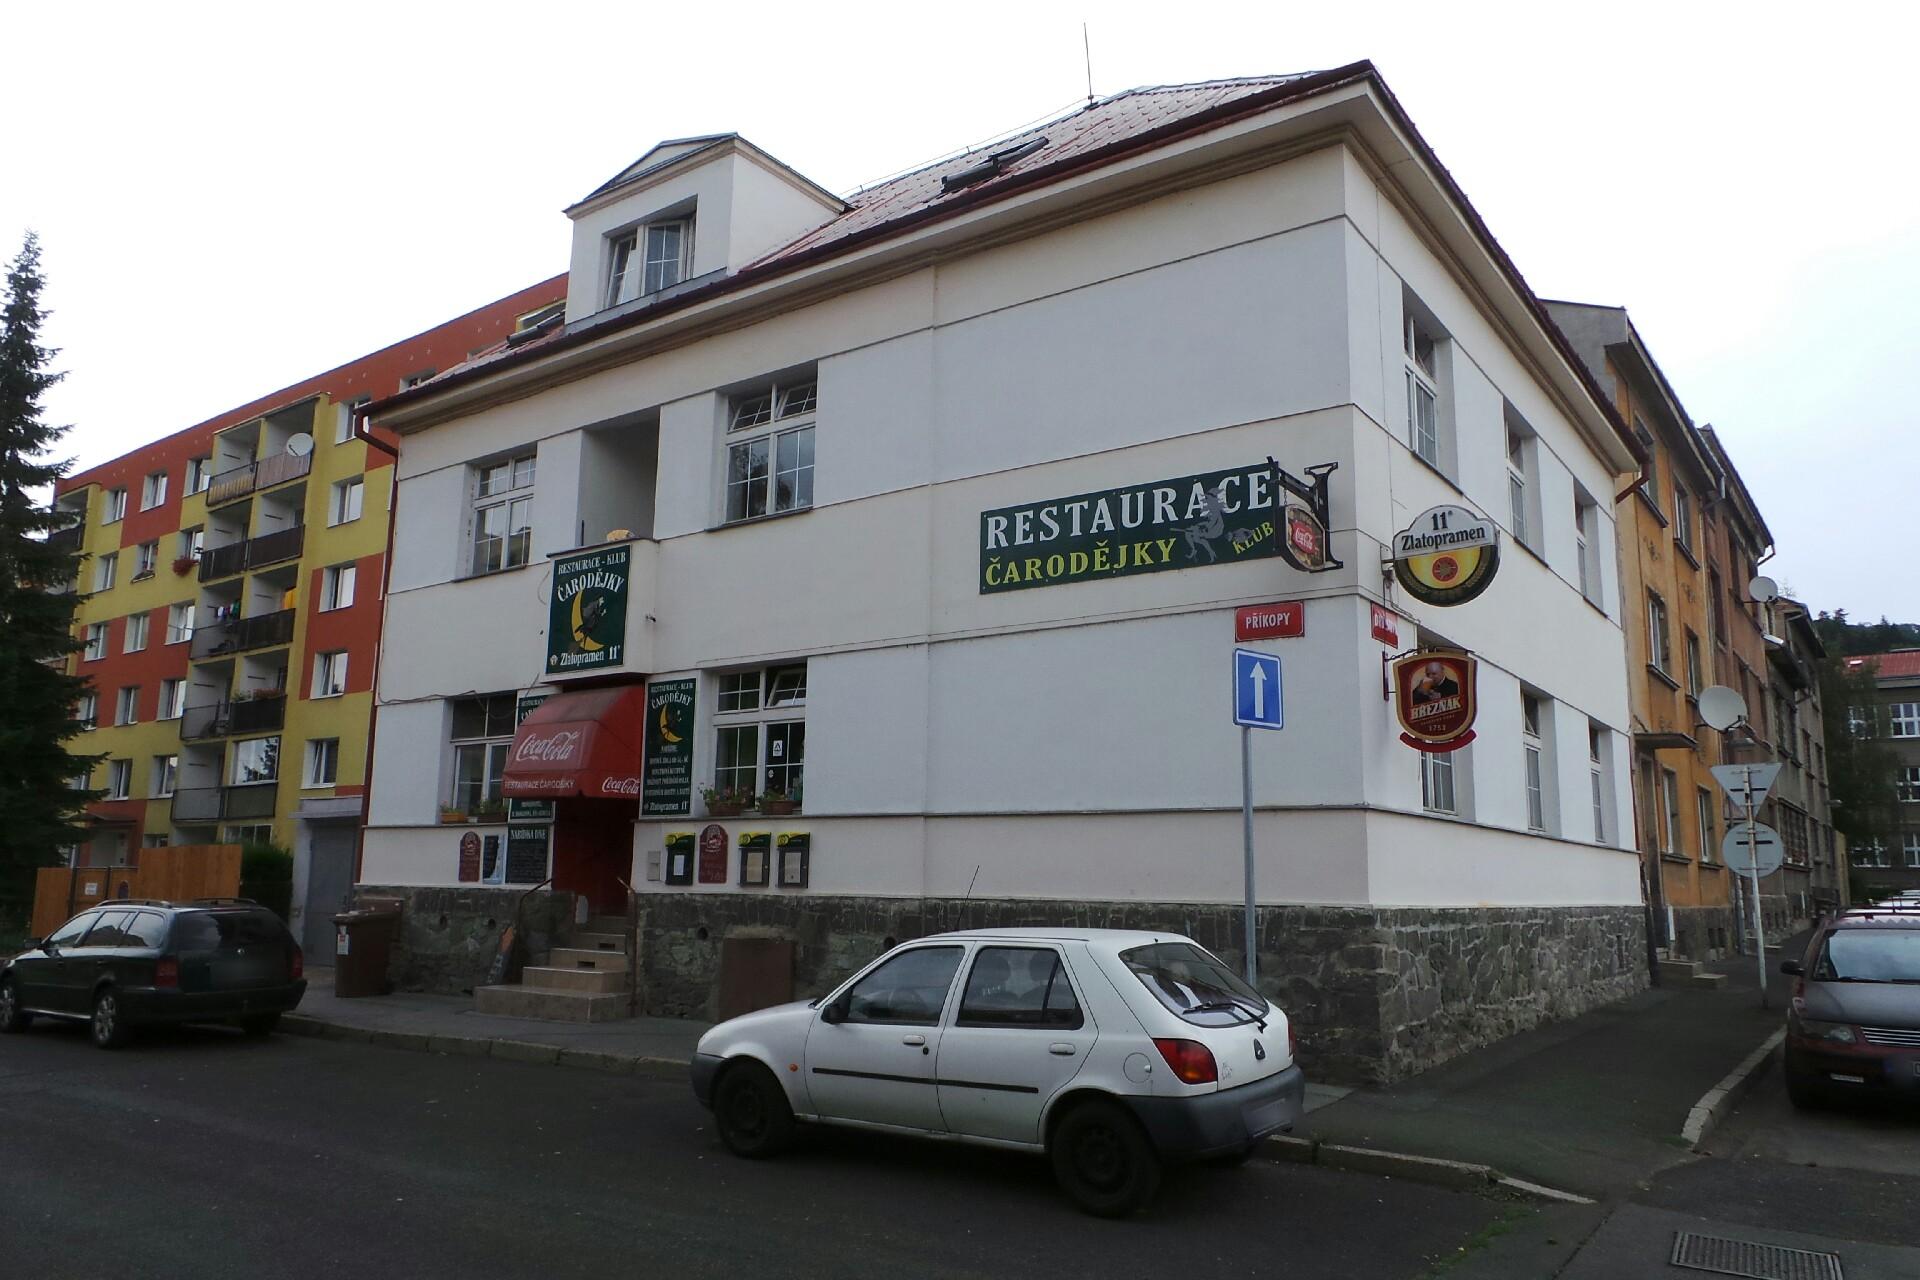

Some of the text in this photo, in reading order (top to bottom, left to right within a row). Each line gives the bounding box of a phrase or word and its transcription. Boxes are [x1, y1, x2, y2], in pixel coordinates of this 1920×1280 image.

[986, 470, 1272, 550] RESTAURACE
[1232, 521, 1274, 554] KLUB
[1401, 526, 1486, 551] Zlatopramen
[558, 556, 601, 575] RESTAURACE
[607, 551, 626, 564] KLUB
[985, 538, 1177, 586] ČARODĚJKY
[557, 568, 625, 602] ČARODĚJKY
[1245, 612, 1291, 629] PŘÍKOPY
[560, 650, 604, 667] Zlatopramen
